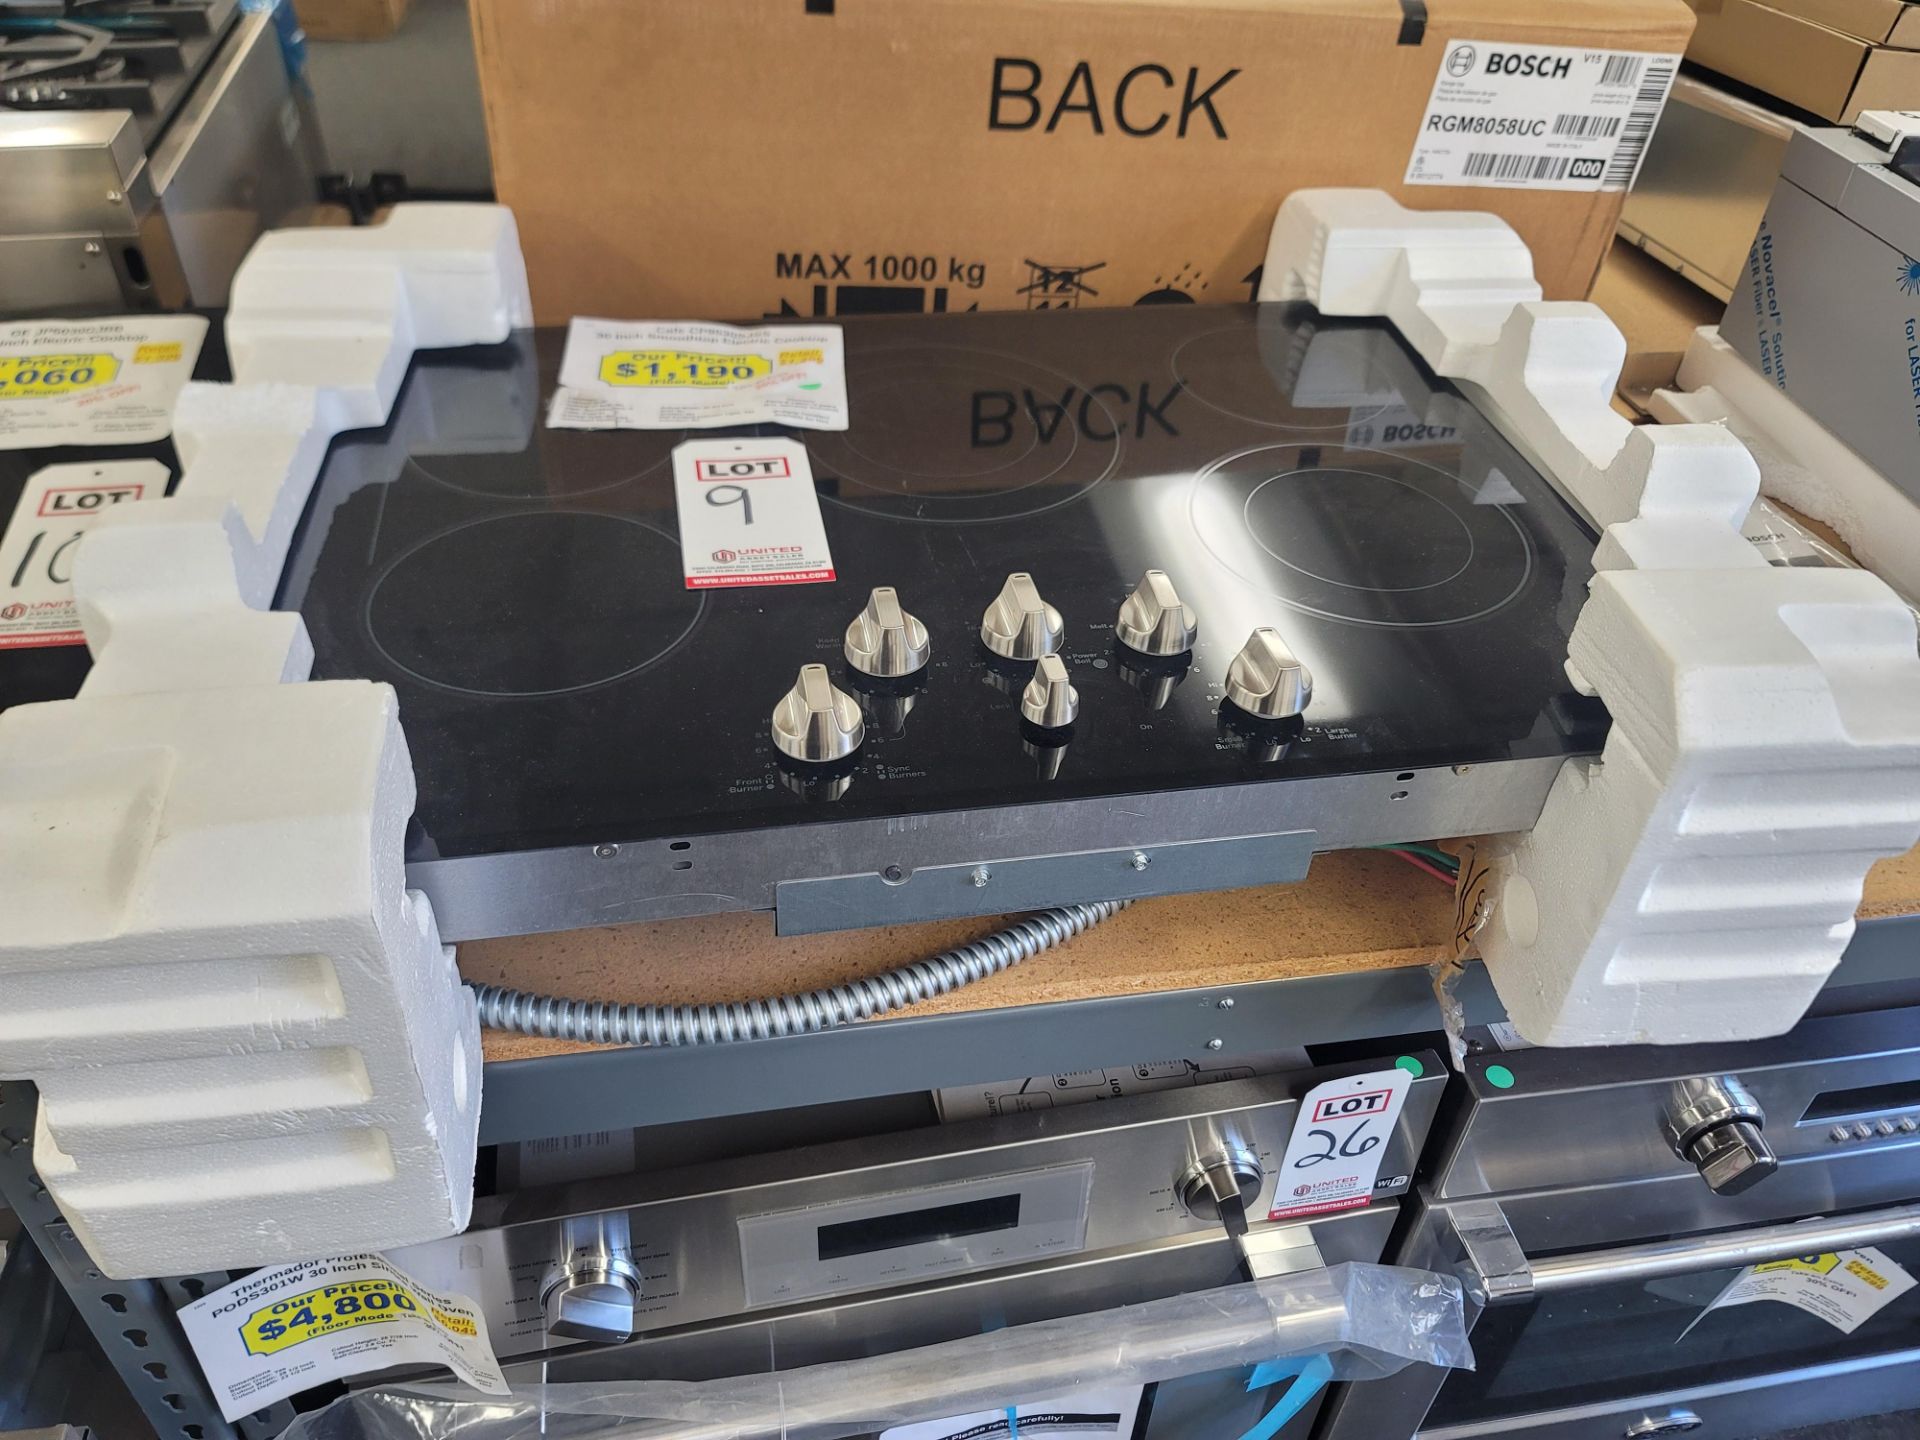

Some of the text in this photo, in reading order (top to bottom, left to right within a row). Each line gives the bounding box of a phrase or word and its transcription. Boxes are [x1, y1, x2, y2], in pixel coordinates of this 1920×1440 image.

[1484, 53, 1573, 78] BOSCH
[988, 57, 1243, 140] BACK
[1427, 114, 1547, 137] RGM8058UC
[1572, 160, 1602, 177] 000
[776, 252, 986, 289] MAX 1000 kg
[1905, 318, 1916, 342] for
[632, 353, 666, 361] Our
[1759, 330, 1772, 375] LASER
[0, 368, 94, 389] ,060
[616, 362, 754, 381] $1,190
[708, 461, 778, 477] LOT
[53, 491, 132, 510] LOT
[705, 485, 754, 526] 9
[738, 546, 803, 554] UNITED
[693, 571, 829, 585] WWW.UNITEDASSETSALES.COM
[31, 600, 75, 609] UNIT
[1324, 727, 1349, 735] Large
[1215, 742, 1246, 750] Burner
[887, 765, 910, 773] Sync
[889, 771, 926, 780] Burners
[729, 785, 764, 793] Burner
[736, 778, 762, 786] Front
[1323, 1094, 1383, 1117] LOT
[1294, 1119, 1380, 1168] 26
[1313, 1176, 1359, 1188] UNITED
[1273, 1198, 1367, 1217] WWW.UNITEDASSETSALES.COM
[1853, 1250, 1874, 1265] ven
[211, 1261, 474, 1319] PODS301W 30 Inch Oven
[231, 1259, 452, 1304] Thermador Series
[272, 1280, 406, 1314] Our Price!!!
[258, 1292, 416, 1341] $4,800
[307, 1313, 394, 1338] (Floor Mode
[228, 1369, 271, 1390] Dimensions
[232, 1385, 254, 1397] Cutout
[233, 1389, 256, 1401] Cutout
[952, 1426, 986, 1440] Please
[1017, 1415, 1065, 1426] carefully!
